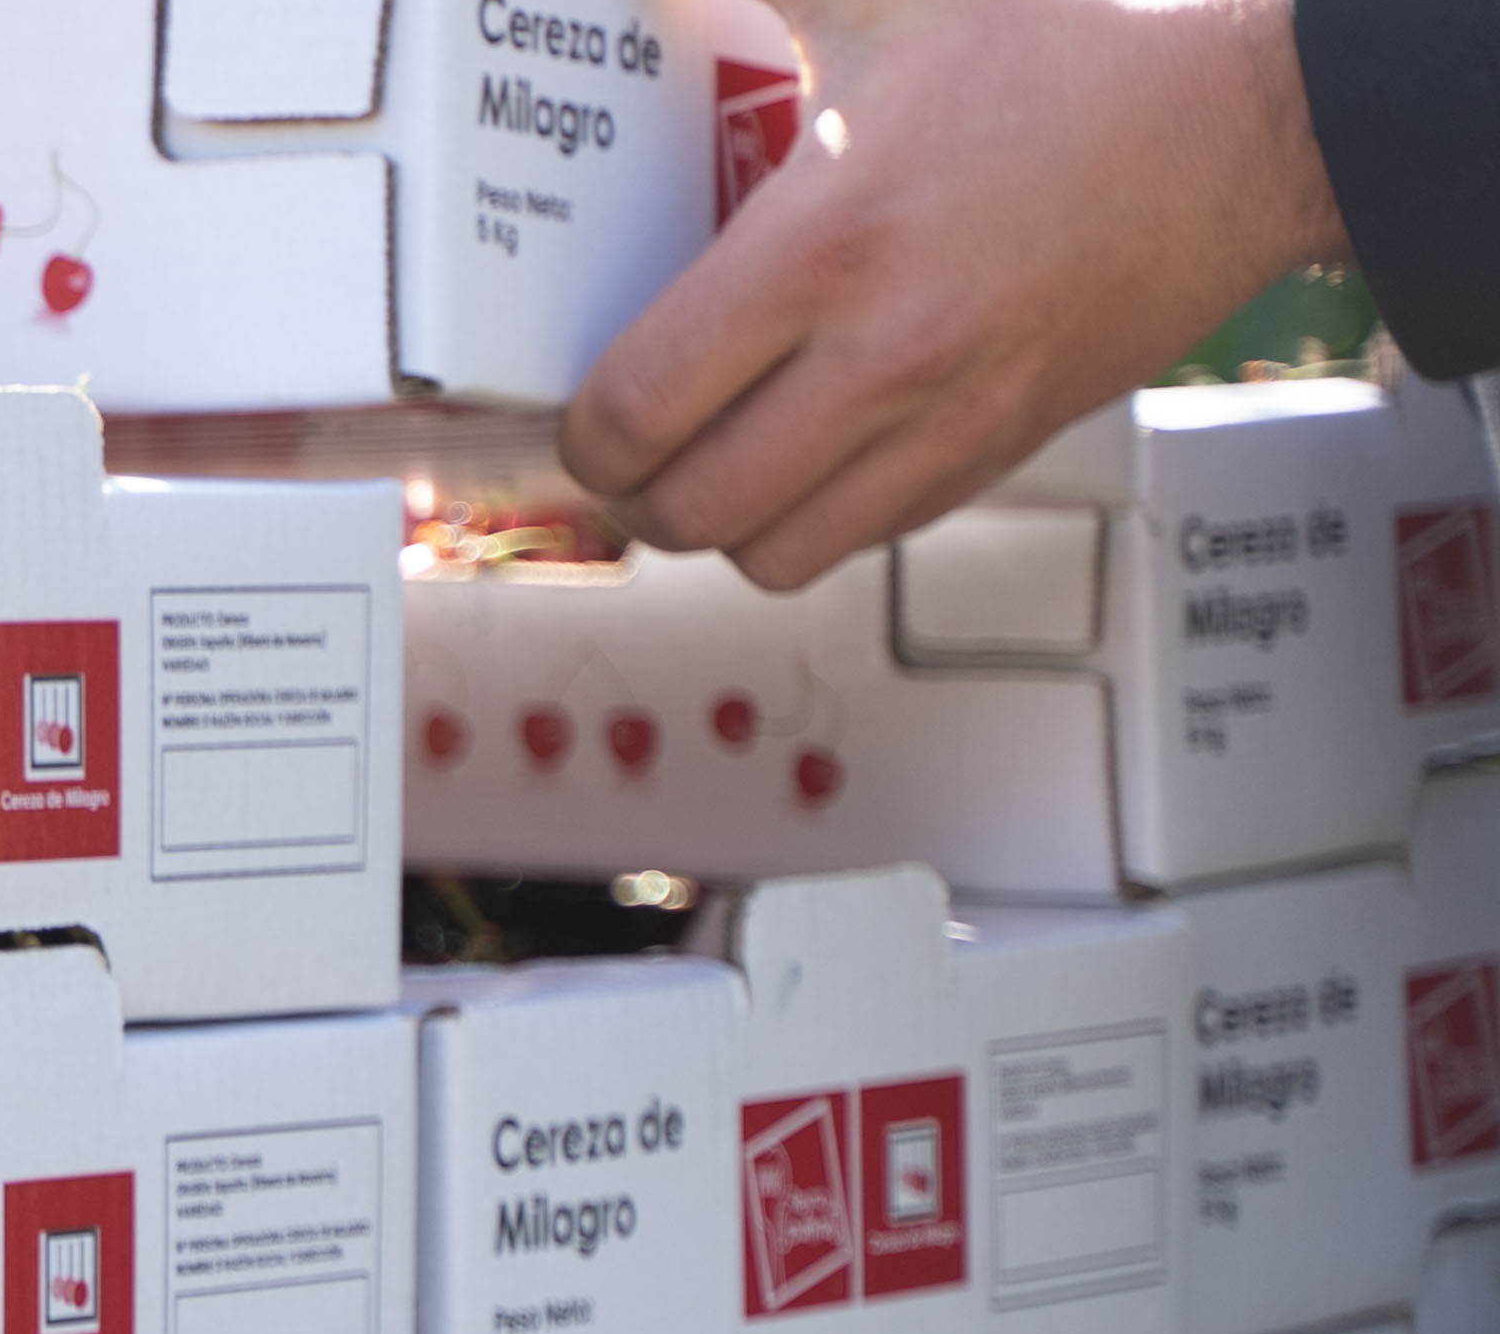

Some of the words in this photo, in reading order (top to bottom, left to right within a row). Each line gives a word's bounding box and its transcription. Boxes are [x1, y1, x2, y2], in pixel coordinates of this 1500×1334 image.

[618, 21, 662, 79] de
[479, 72, 616, 156] Milagro
[493, 1112, 626, 1174] Cereza
[638, 1093, 685, 1153] de
[493, 1192, 636, 1260] Milagro
